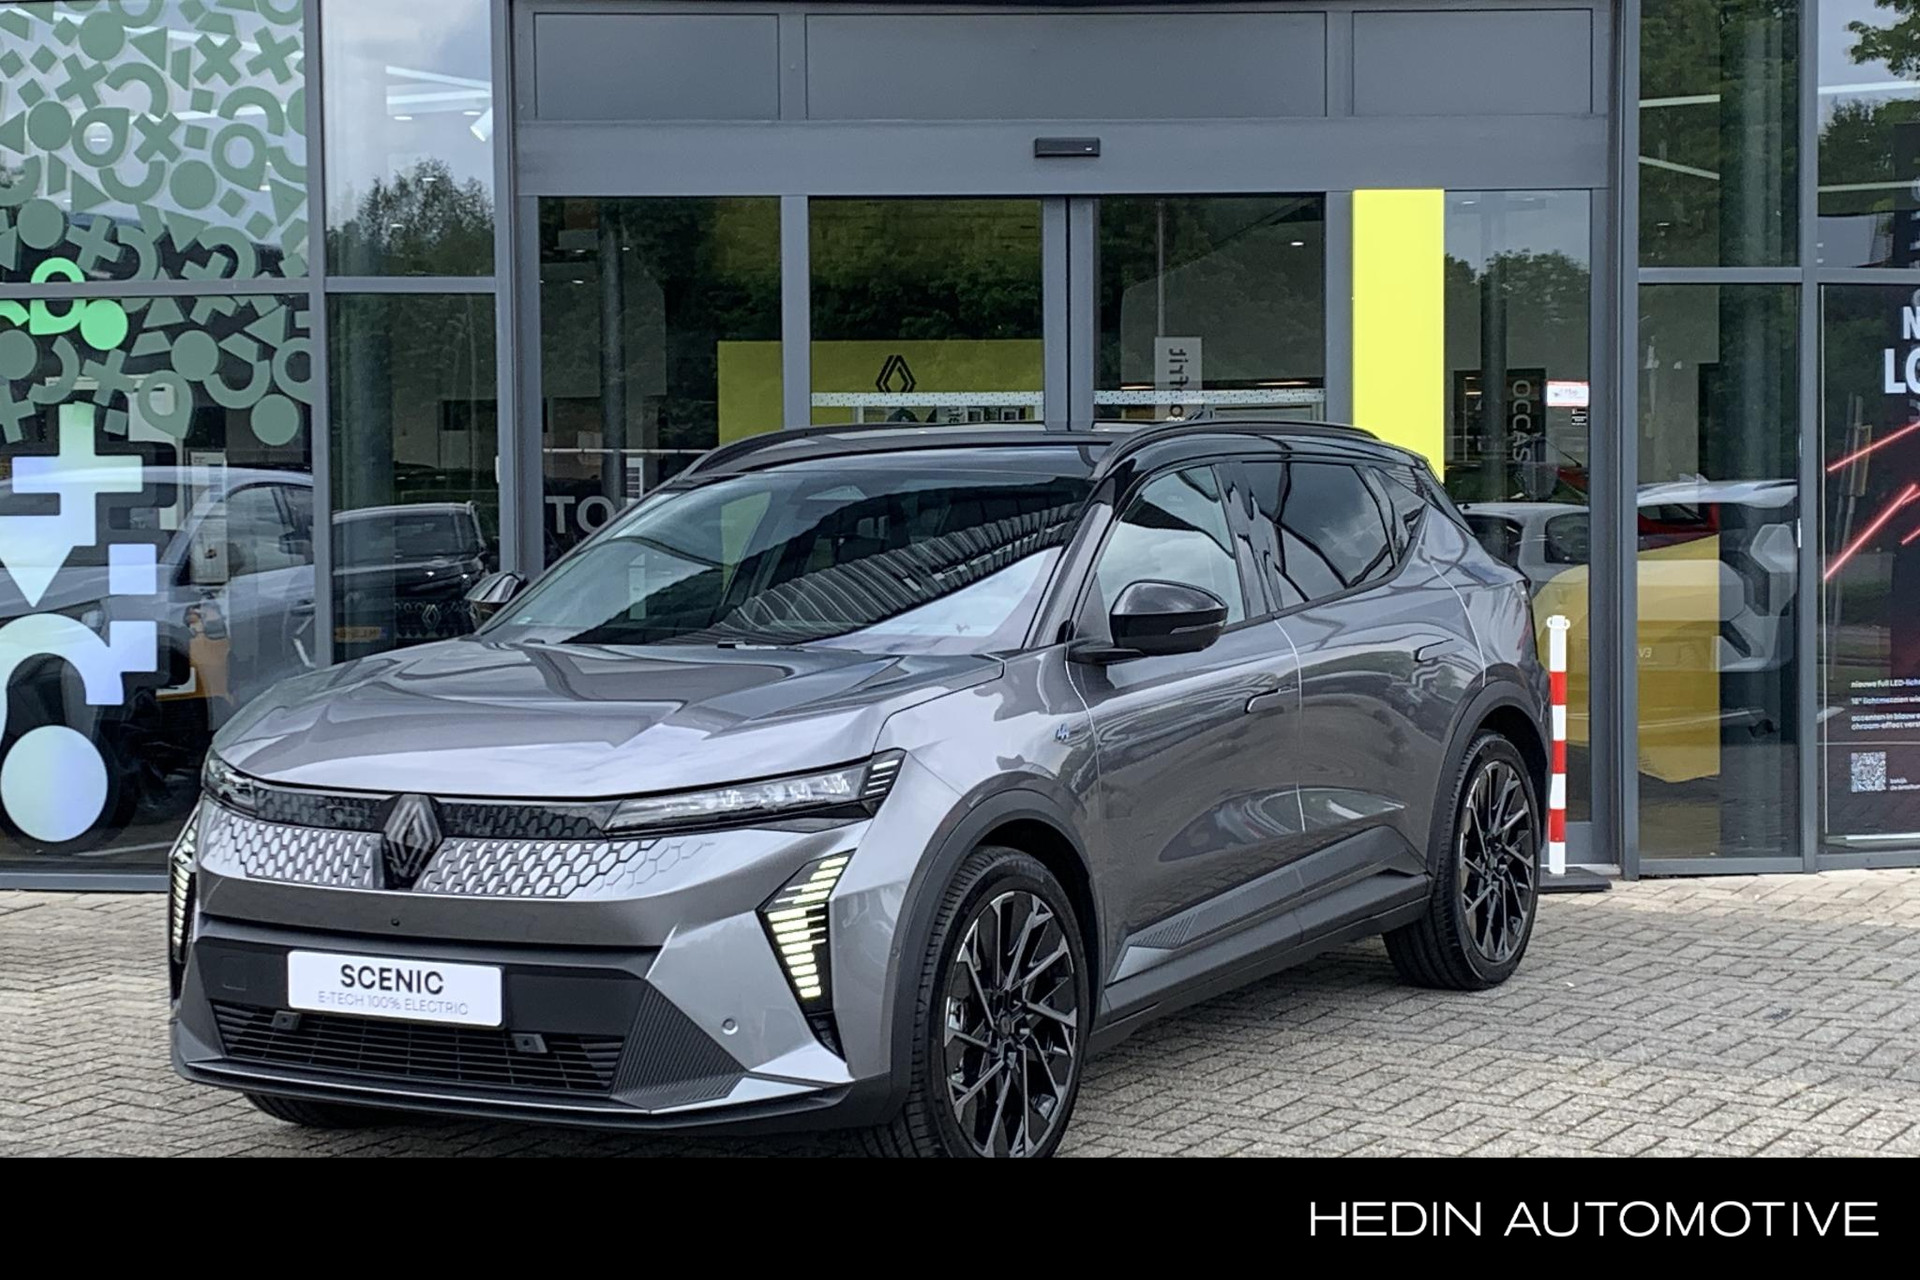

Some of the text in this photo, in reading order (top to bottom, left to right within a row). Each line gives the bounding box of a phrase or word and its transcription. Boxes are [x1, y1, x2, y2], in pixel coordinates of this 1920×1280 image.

[340, 964, 444, 995] SCENIC
[318, 990, 469, 1016] E-TECH 100% ELECTRIC
